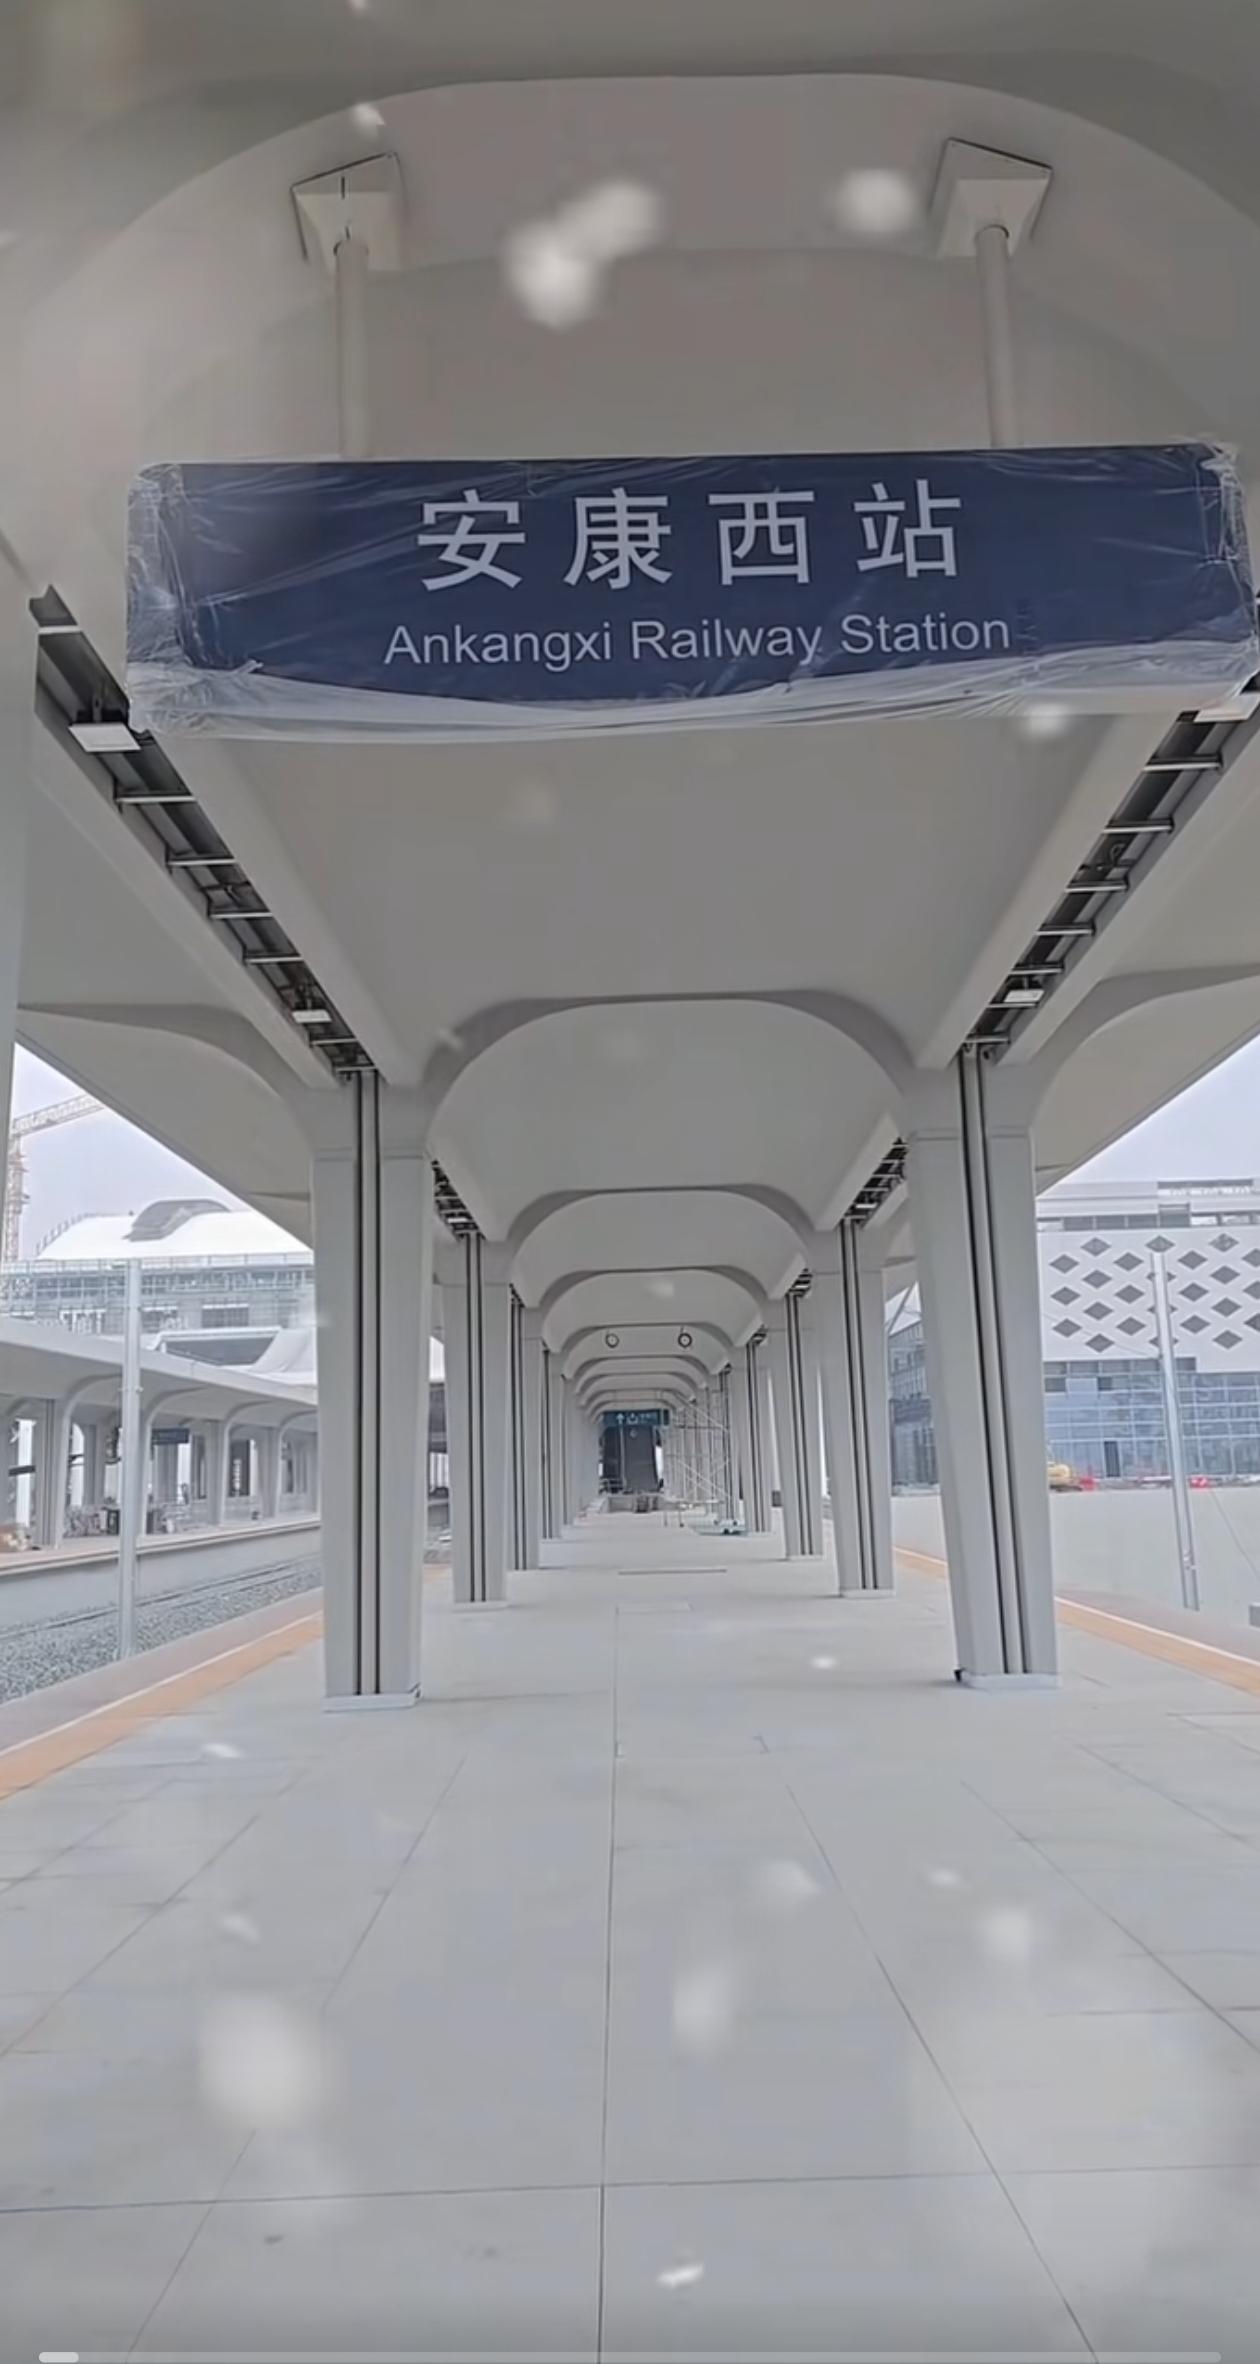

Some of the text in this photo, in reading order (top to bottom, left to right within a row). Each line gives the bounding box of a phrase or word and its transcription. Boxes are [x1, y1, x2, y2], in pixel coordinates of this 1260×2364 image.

[417, 479, 961, 591] 安康西站
[384, 611, 1010, 672] Ankangxi Railway Station
